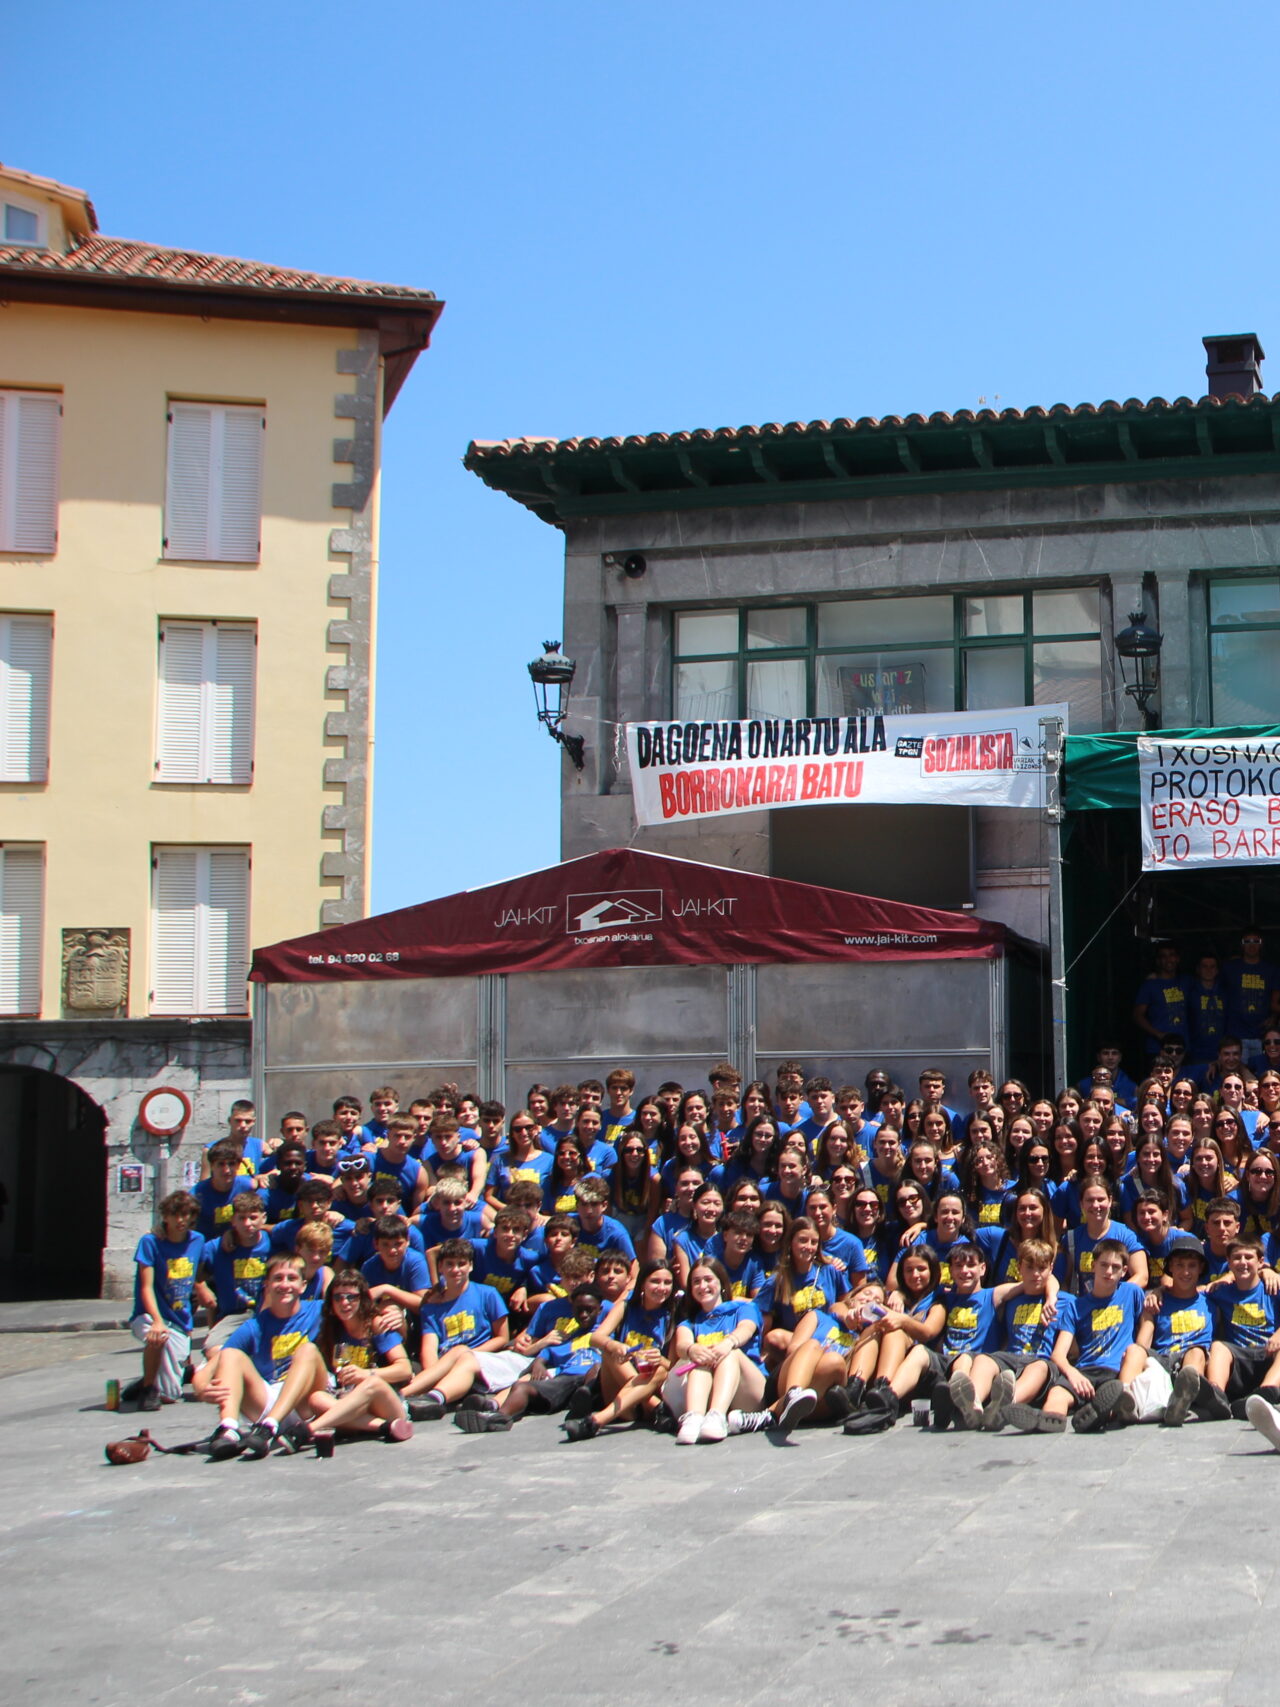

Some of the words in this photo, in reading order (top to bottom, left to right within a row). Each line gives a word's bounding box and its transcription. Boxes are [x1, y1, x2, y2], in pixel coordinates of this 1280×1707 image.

[637, 722, 743, 769] DAGOENA
[749, 717, 840, 758] ONARTU
[843, 715, 887, 753] ALA
[897, 740, 922, 749] GAZTE
[924, 732, 1013, 773] SOZIALISTA
[659, 763, 798, 818] BORROKARA
[801, 761, 865, 799] BATU
[1152, 798, 1240, 830] ERASO
[1152, 835, 1190, 863] JO
[494, 906, 557, 928] JAI-KIT
[672, 898, 738, 917] JAI-KIT
[844, 934, 937, 946] www.jai-kit.com
[308, 955, 325, 964] tel.
[327, 954, 342, 964] 94
[344, 953, 366, 963] 620
[368, 953, 383, 962] 02
